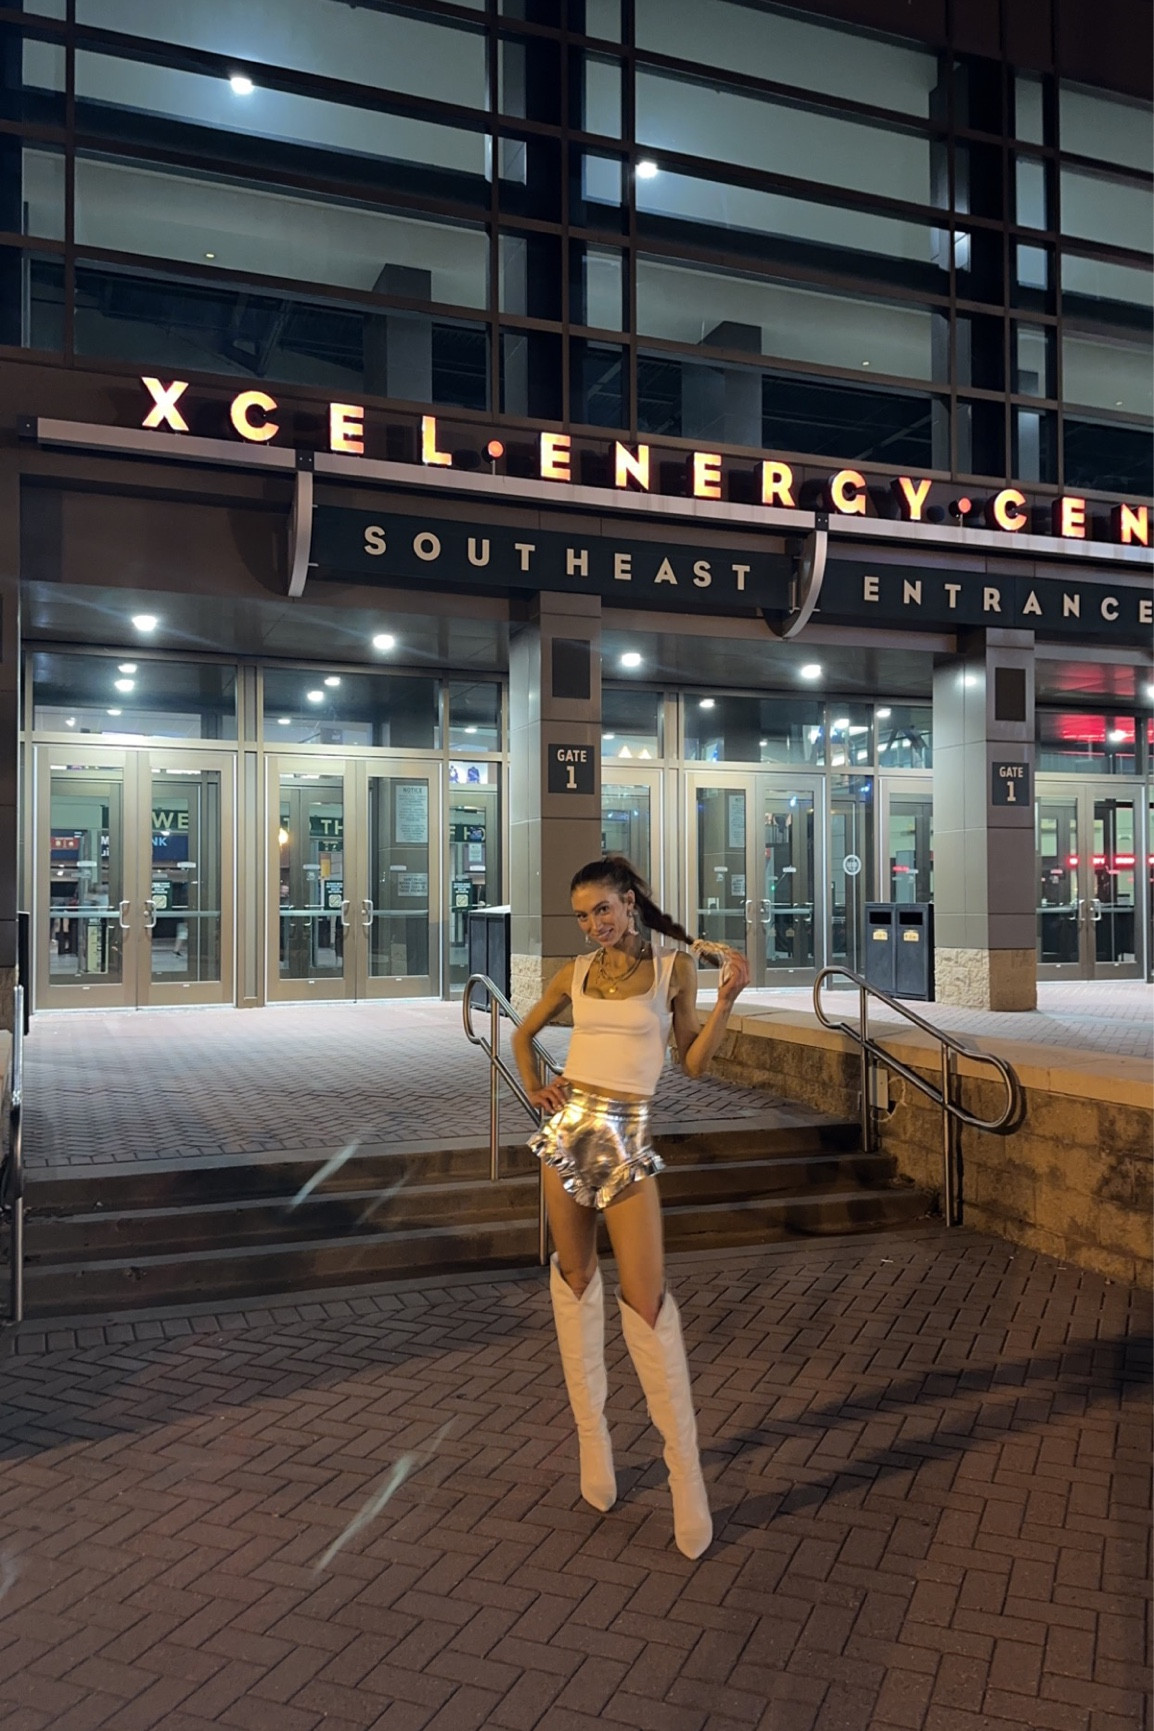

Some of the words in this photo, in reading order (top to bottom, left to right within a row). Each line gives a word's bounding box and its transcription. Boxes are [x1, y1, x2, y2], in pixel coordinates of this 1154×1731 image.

[141, 376, 452, 466] XCEL
[539, 432, 931, 522] ENERGY
[993, 488, 1148, 545] CEN
[364, 526, 751, 591] SOUTHEAST
[864, 576, 1153, 623] ENTRANCE
[557, 749, 587, 762] GATE
[566, 765, 577, 789] 1
[999, 766, 1024, 778] GATE
[1006, 780, 1016, 802] 1
